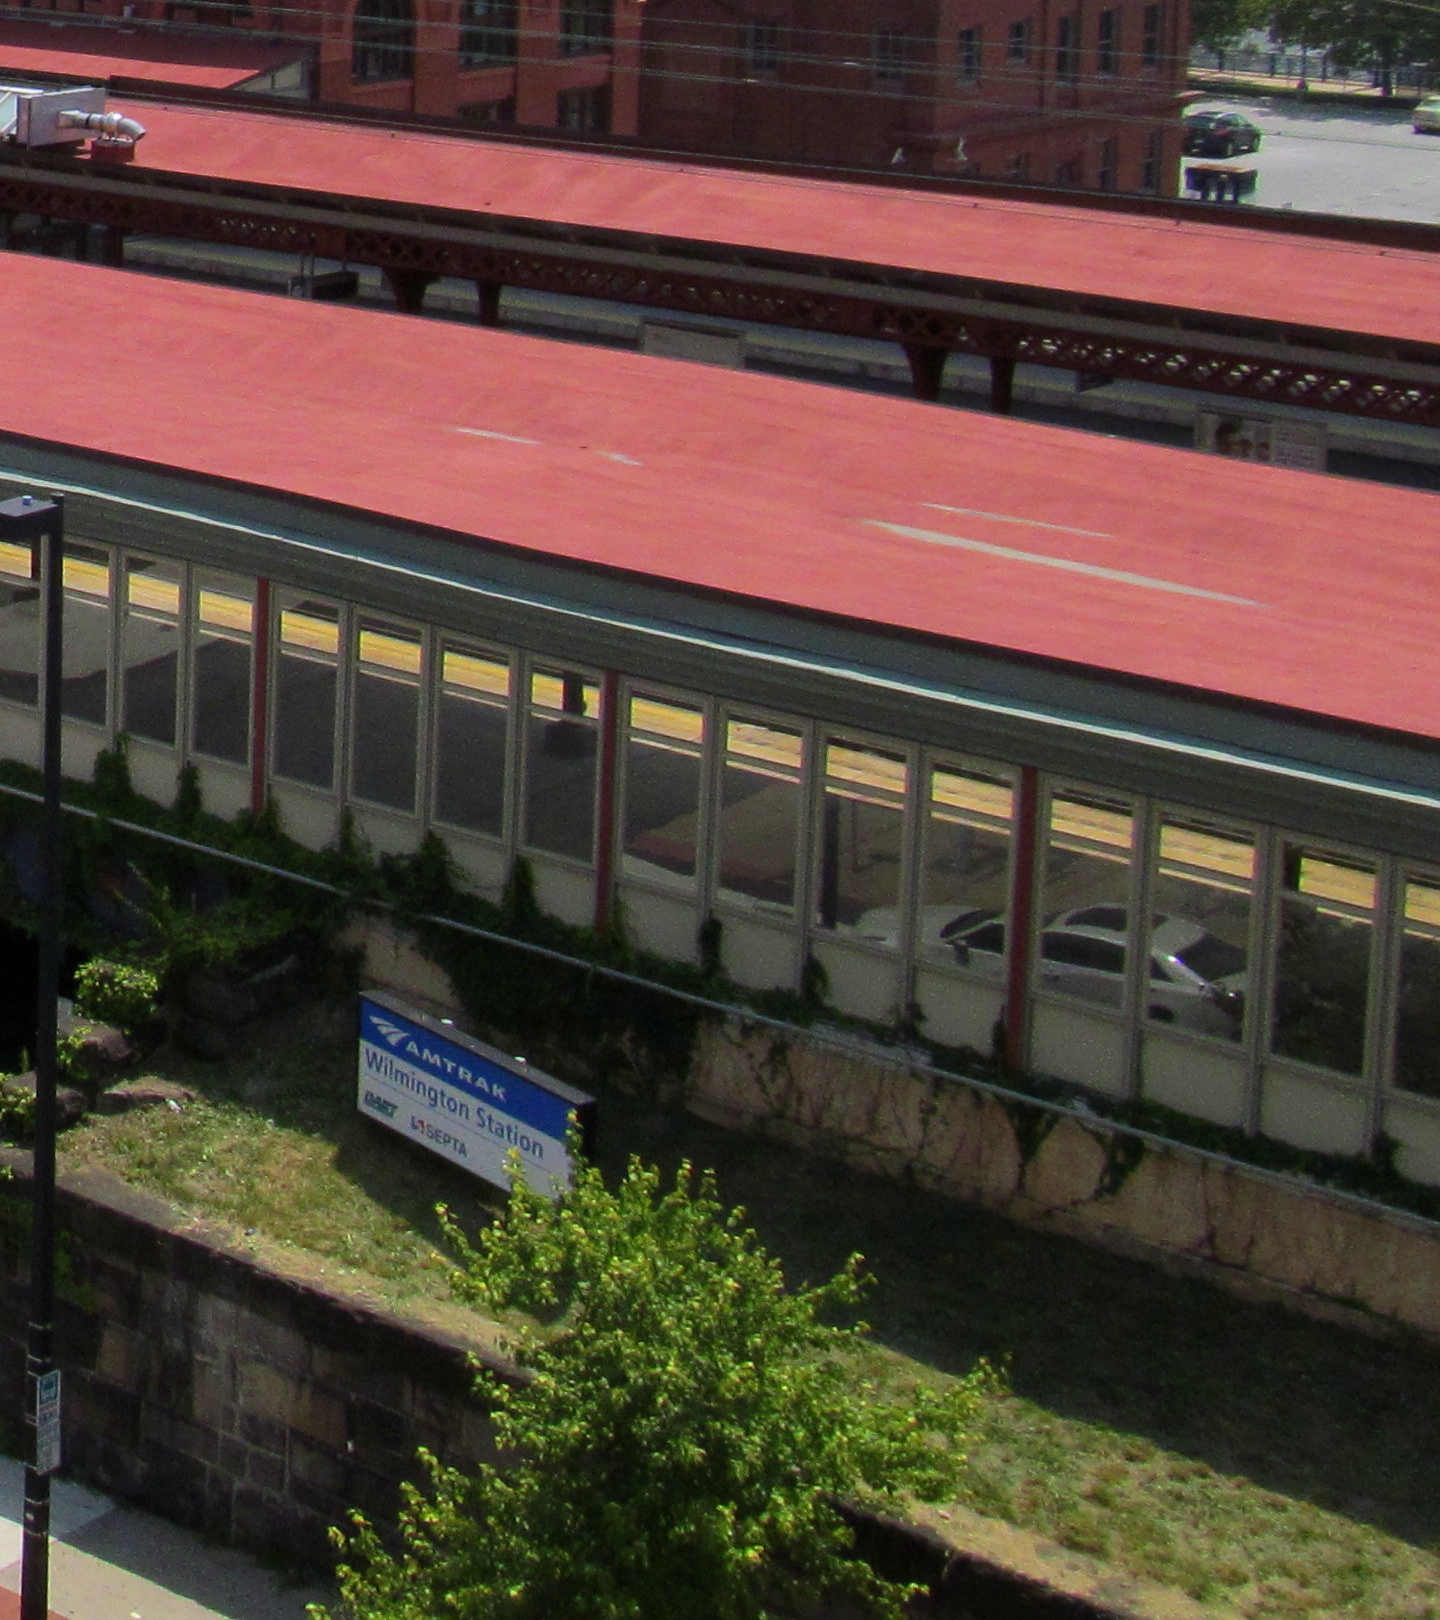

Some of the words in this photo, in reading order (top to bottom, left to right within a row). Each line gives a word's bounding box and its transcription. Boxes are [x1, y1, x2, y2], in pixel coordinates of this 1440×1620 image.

[365, 1046, 470, 1121] Wilmington
[476, 1106, 544, 1160] Station
[406, 1041, 508, 1103] AMTRAK
[426, 1125, 468, 1158] SEPTA
